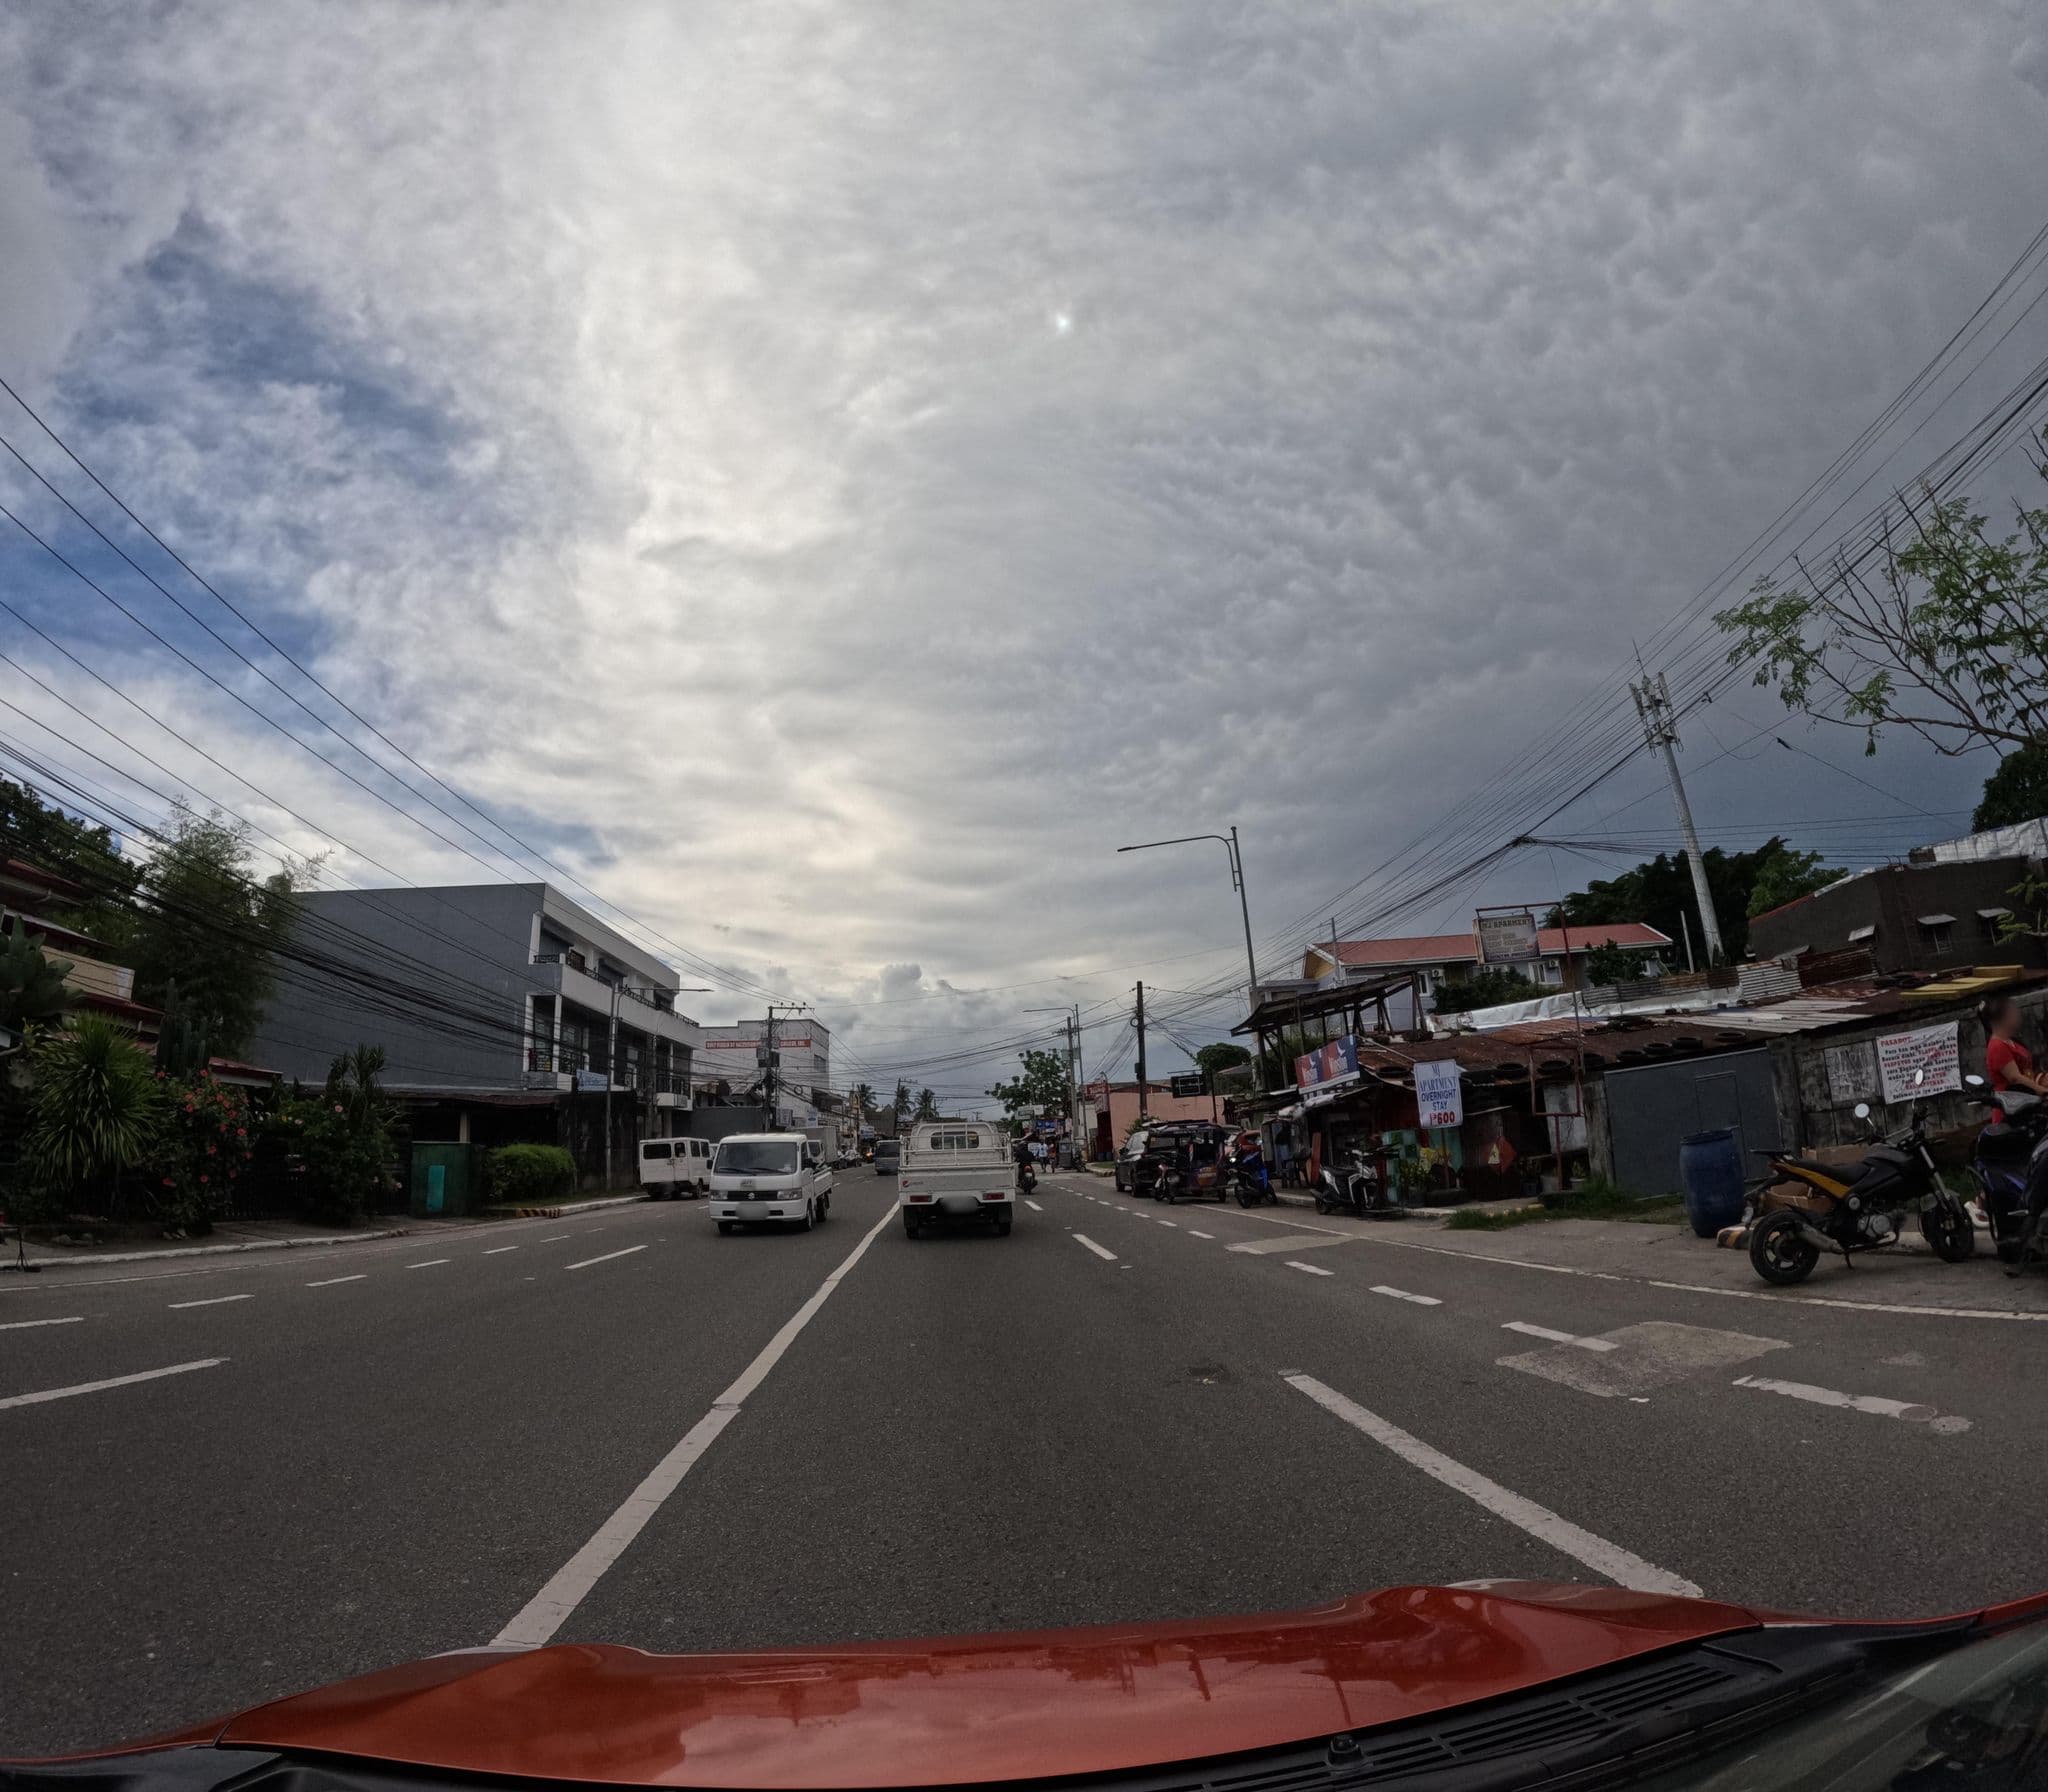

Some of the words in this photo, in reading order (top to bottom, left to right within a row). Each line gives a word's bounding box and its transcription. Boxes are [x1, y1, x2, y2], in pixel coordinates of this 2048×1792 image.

[1420, 1076, 1457, 1091] APARTMENT
[1421, 1089, 1457, 1102] OVERNIGHT
[1432, 1101, 1448, 1111] STAY
